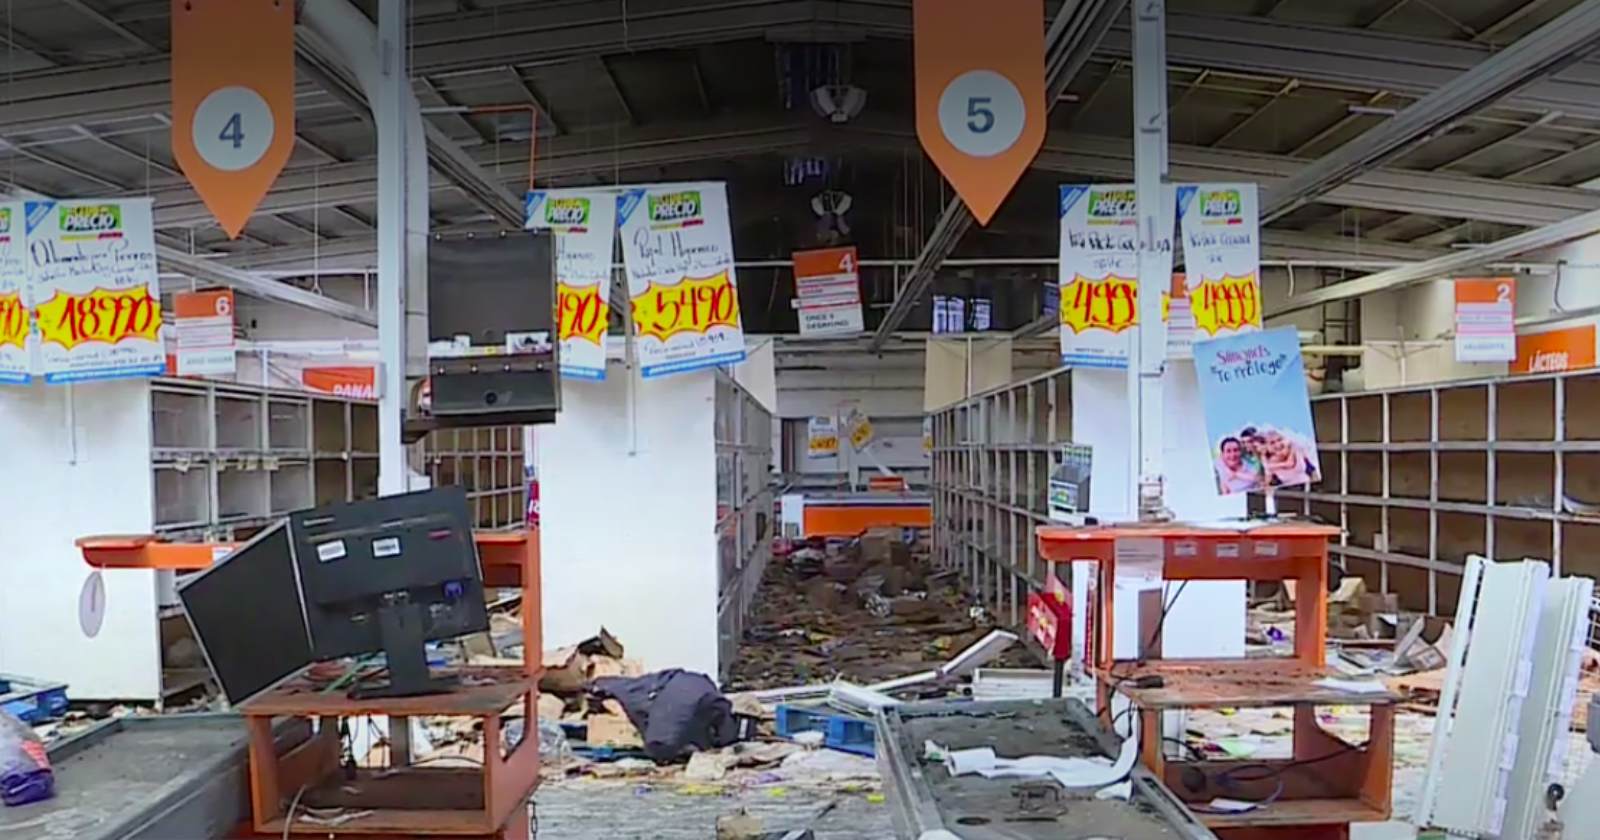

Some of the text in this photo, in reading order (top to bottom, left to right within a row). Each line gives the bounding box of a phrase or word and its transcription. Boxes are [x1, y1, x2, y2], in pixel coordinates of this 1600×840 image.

[967, 97, 995, 133] 5
[218, 112, 245, 149] 4
[654, 200, 698, 221] PRECIO
[838, 253, 854, 273] 4
[215, 296, 231, 316] 6
[1204, 281, 1257, 325] 4999
[1497, 283, 1512, 303] 2
[652, 284, 733, 332] 5490
